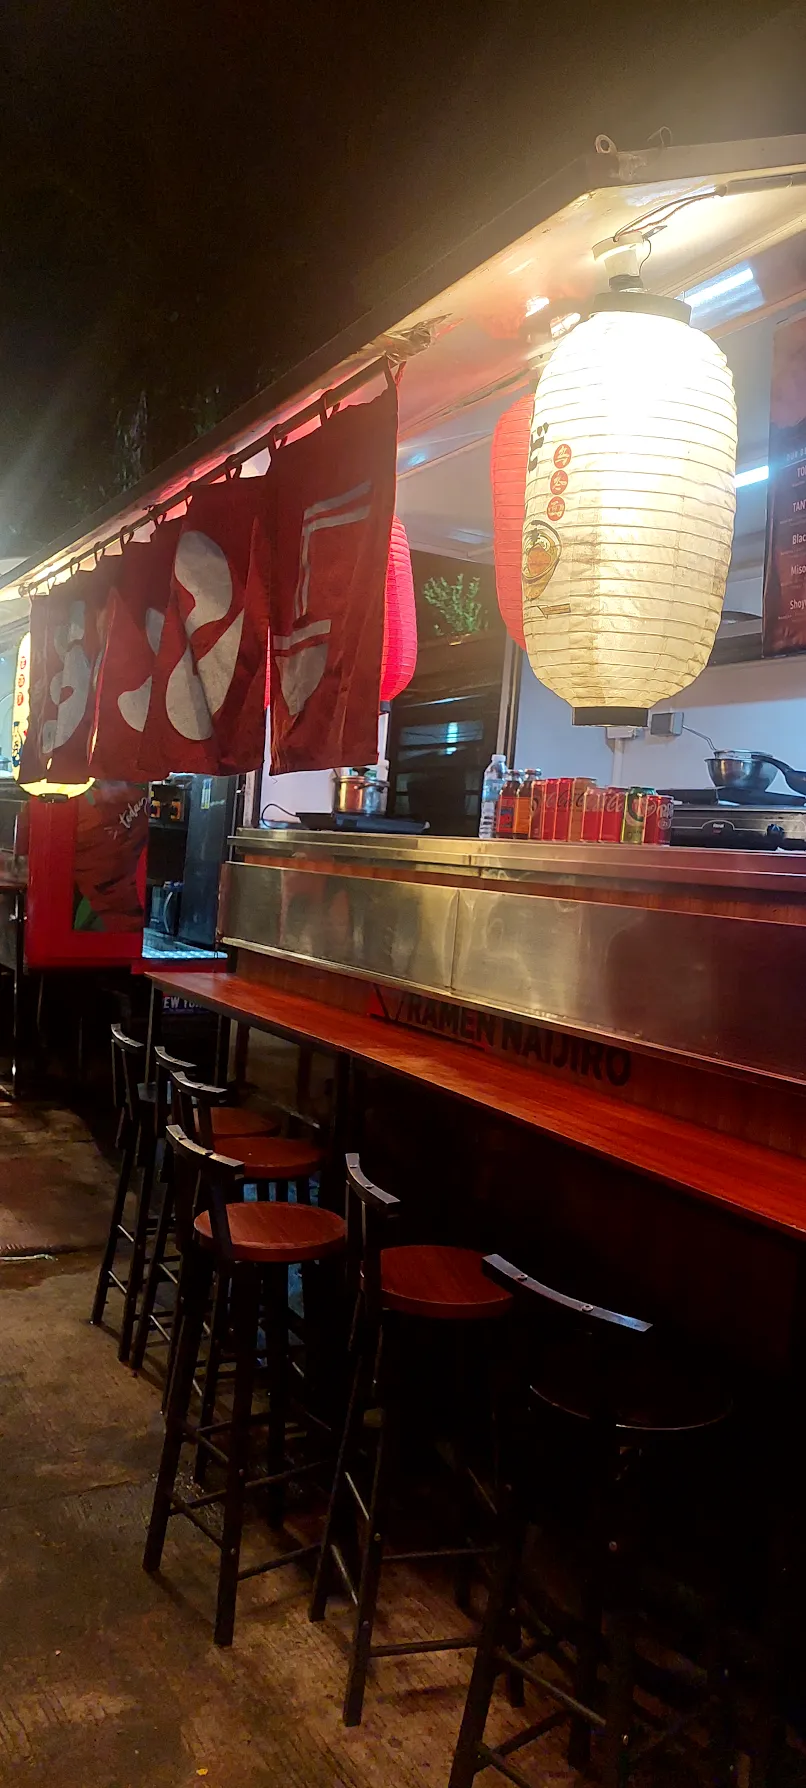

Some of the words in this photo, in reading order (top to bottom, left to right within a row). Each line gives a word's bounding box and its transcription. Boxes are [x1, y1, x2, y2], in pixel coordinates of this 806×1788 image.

[792, 498, 806, 513] TAN
[790, 564, 806, 576] Miso
[163, 996, 180, 1009] EW
[406, 994, 496, 1047] RAMEN
